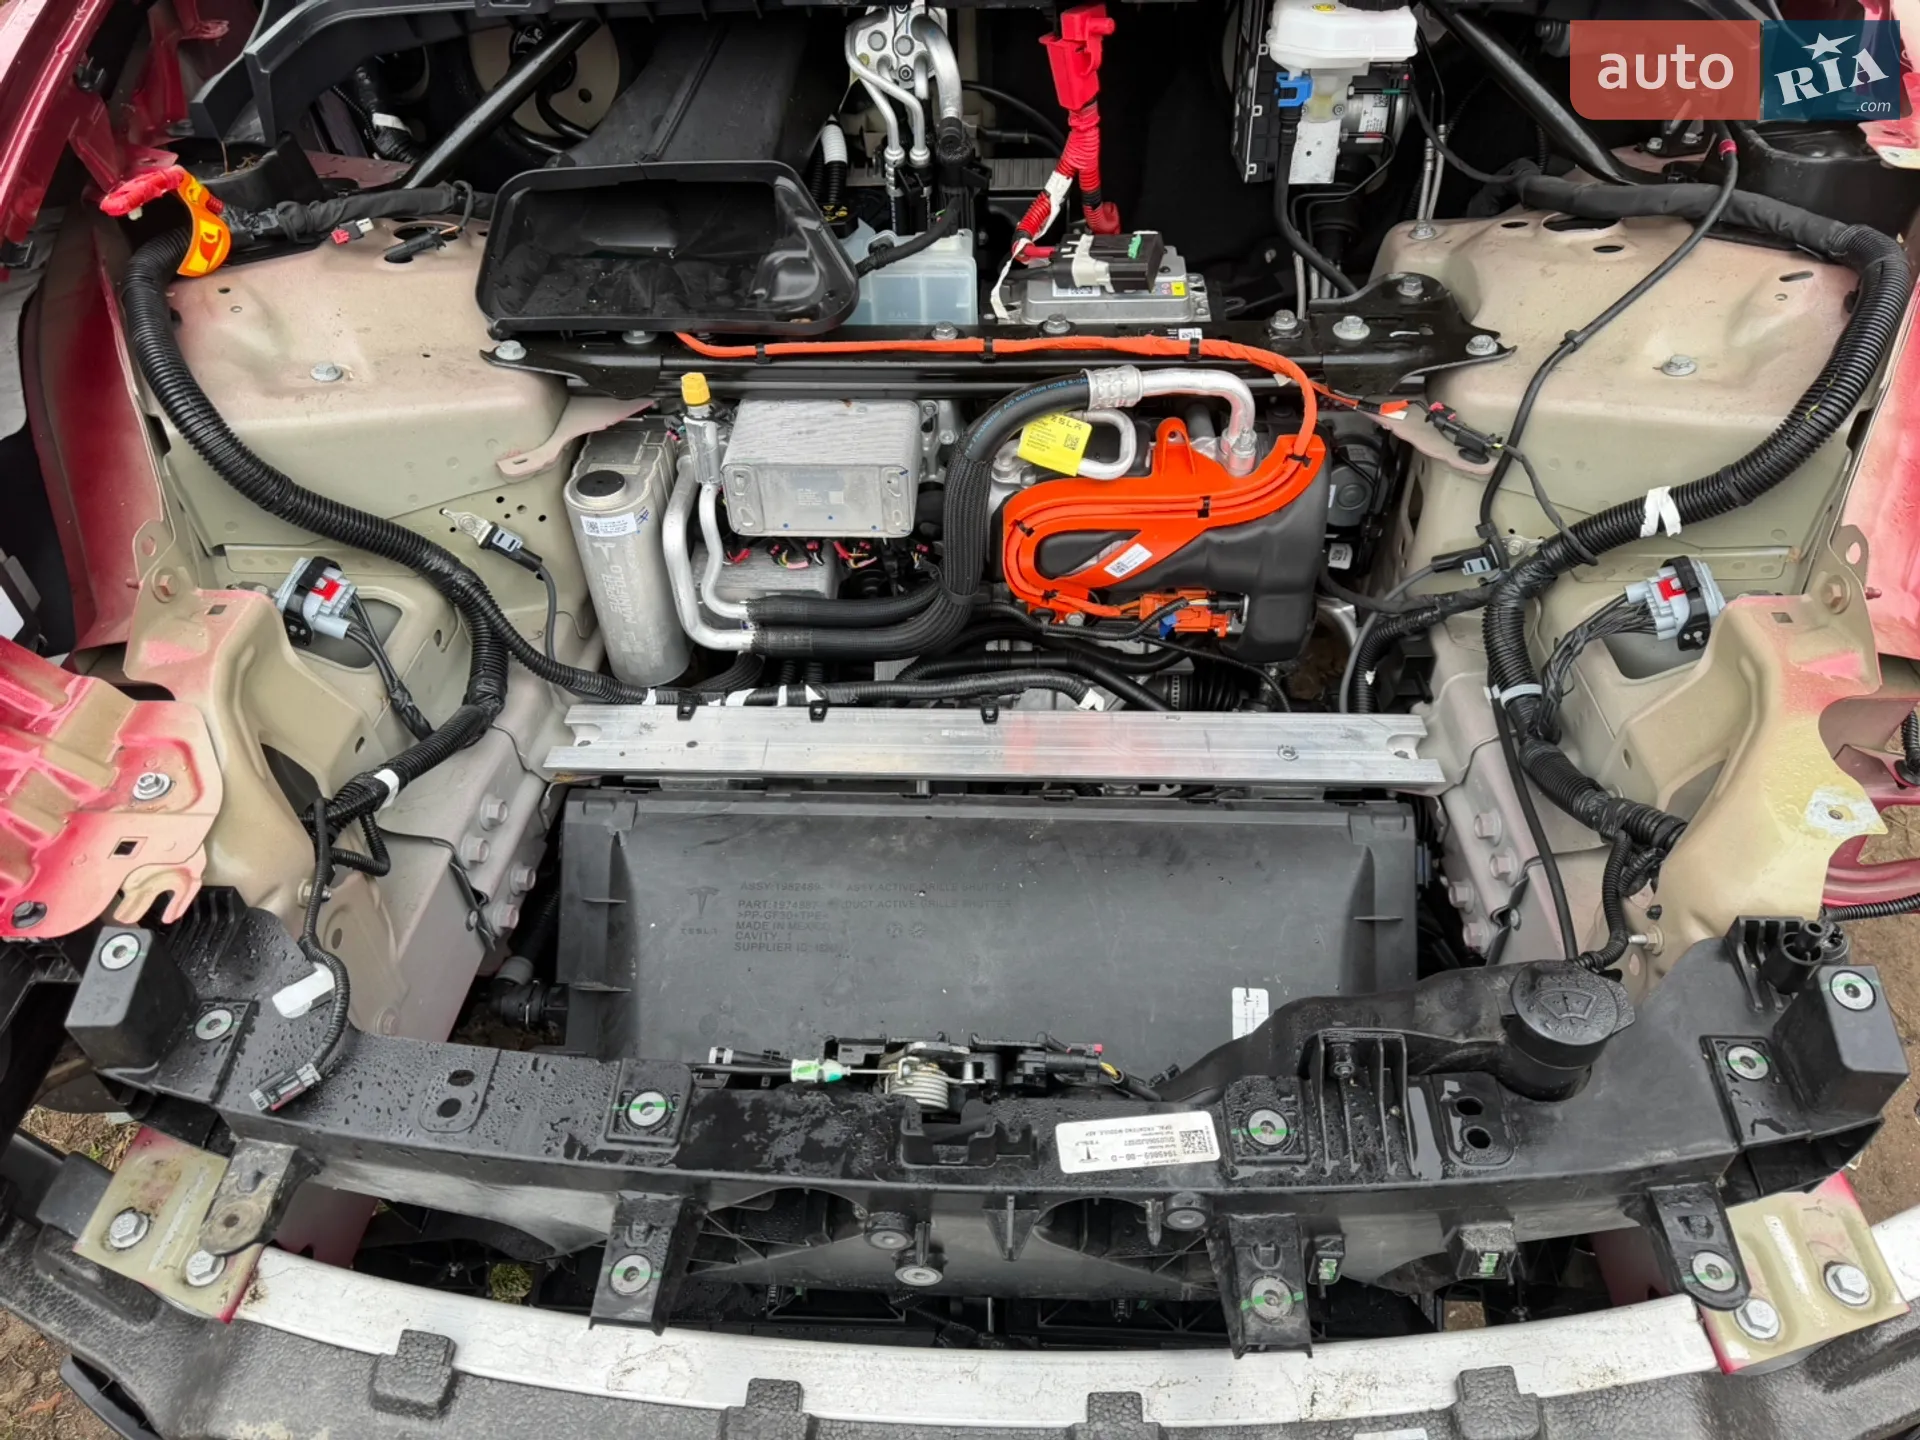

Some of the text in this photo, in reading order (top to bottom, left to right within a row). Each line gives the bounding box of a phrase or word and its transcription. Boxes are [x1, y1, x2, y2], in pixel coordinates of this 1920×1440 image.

[962, 882, 1009, 892] SHUTER
[736, 921, 831, 931] MADE IN MEXICO
[734, 942, 793, 952] SUPPLIER
